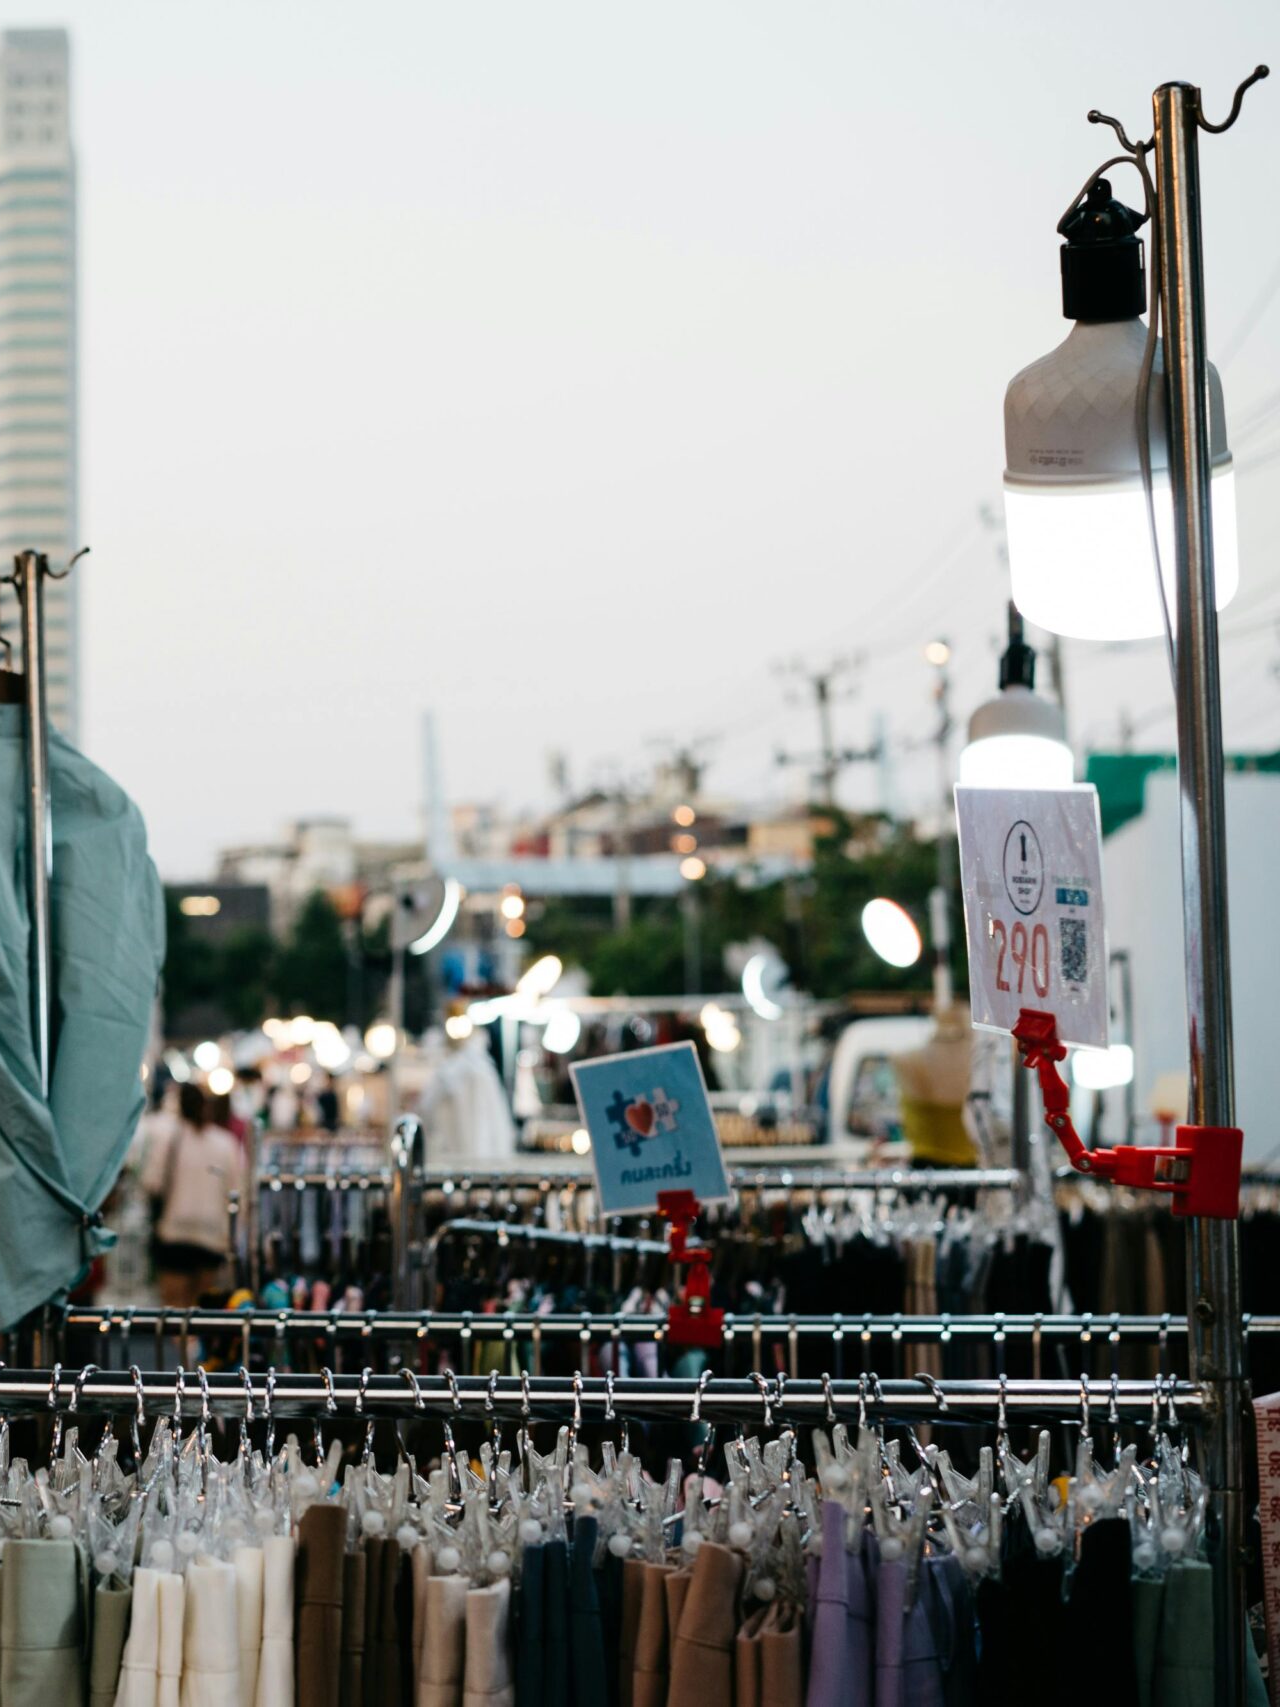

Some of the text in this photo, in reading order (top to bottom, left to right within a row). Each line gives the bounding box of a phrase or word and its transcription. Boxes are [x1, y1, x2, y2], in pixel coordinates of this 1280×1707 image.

[992, 919, 1049, 998] 290
[1267, 1408, 1280, 1432] 31
[1269, 1451, 1280, 1477] 30
